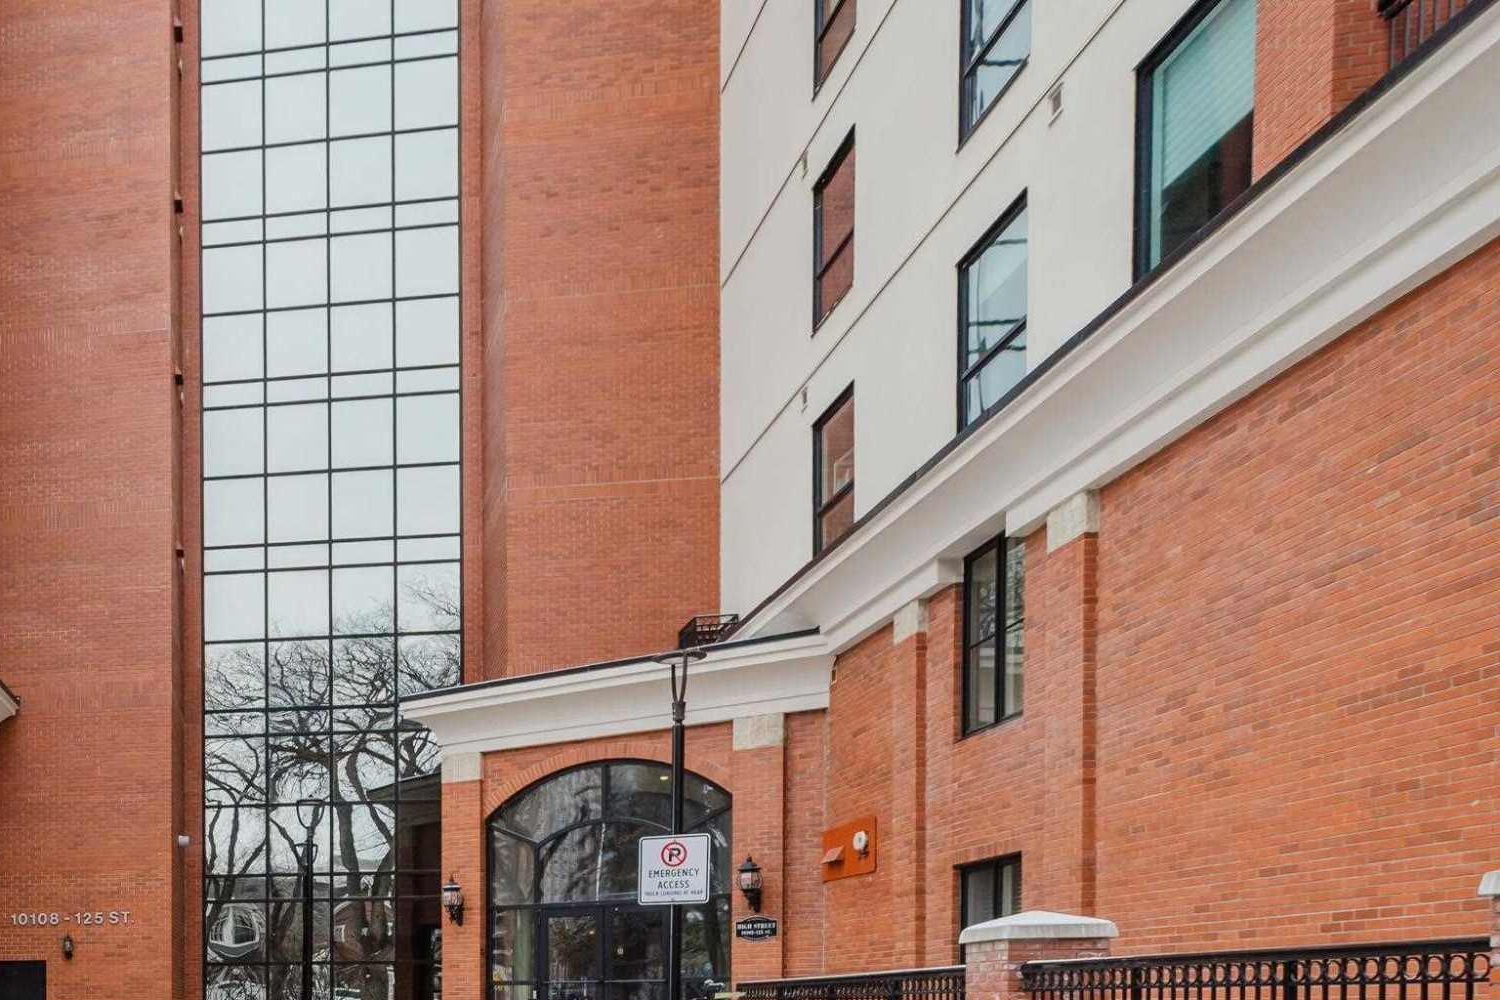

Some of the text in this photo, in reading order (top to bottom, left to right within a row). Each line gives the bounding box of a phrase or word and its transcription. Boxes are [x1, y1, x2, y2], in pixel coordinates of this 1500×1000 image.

[648, 868, 700, 878] EMERGENCY
[657, 880, 690, 889] ACCESS
[10, 912, 59, 925] 10108
[74, 912, 103, 924] 125
[109, 911, 135, 924] ST.
